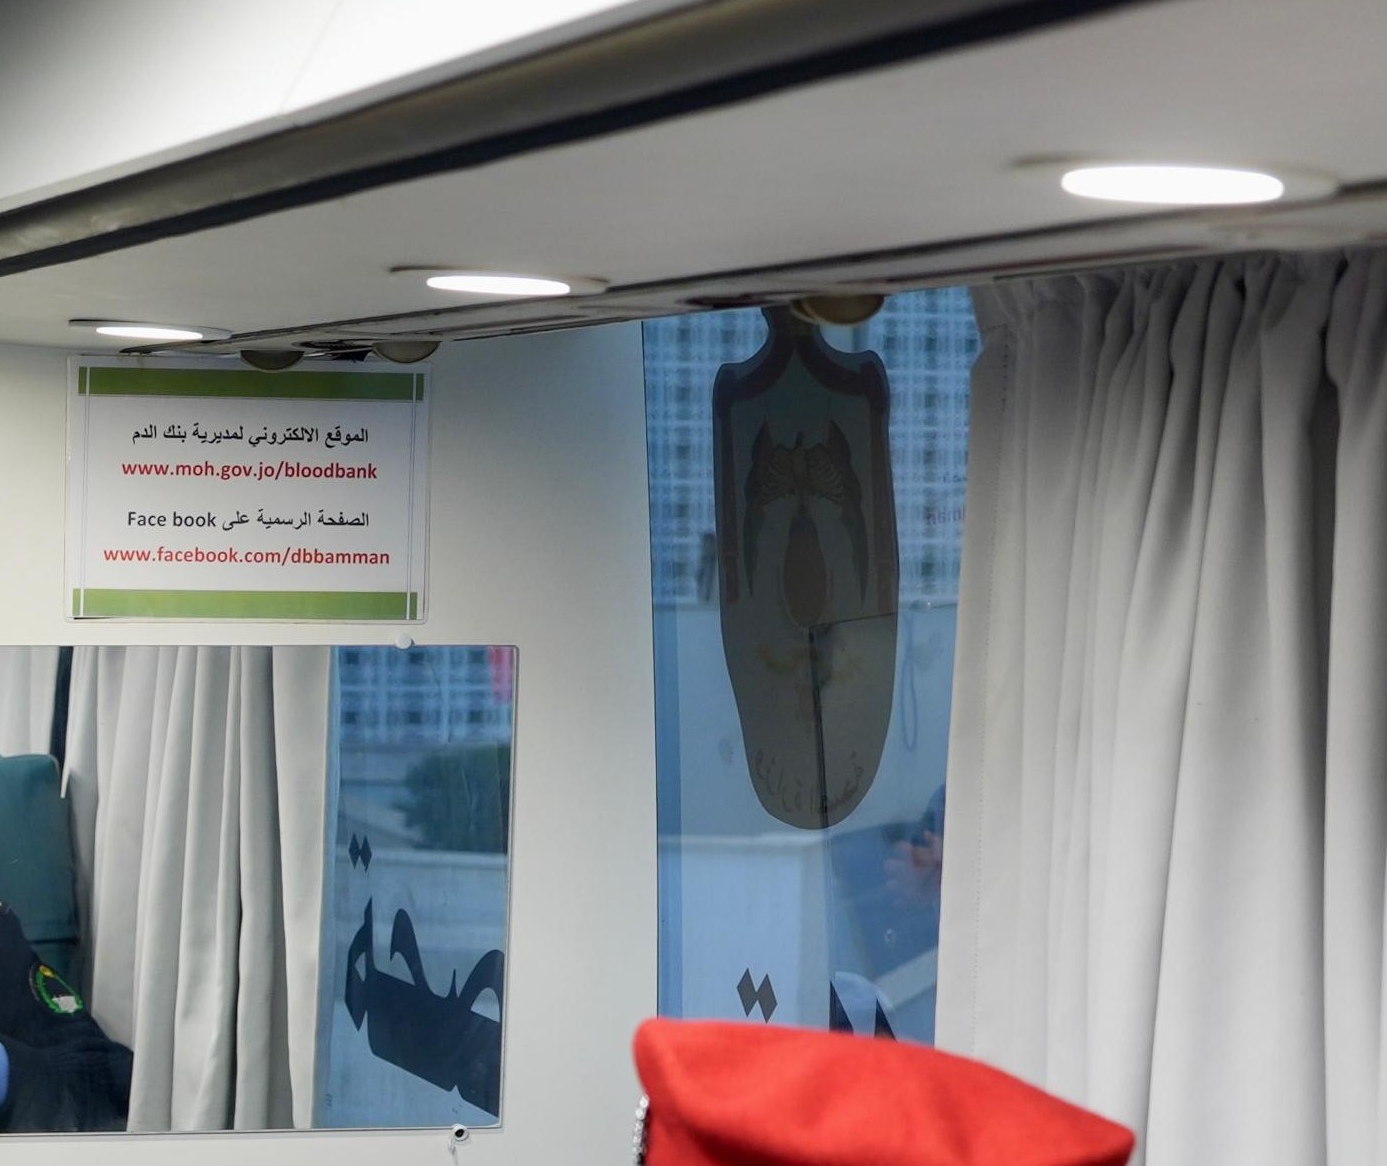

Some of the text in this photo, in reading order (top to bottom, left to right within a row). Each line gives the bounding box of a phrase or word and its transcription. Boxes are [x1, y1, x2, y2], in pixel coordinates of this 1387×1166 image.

[131, 421, 369, 449] الموقع الالكتروني لمديرية بنك الدم
[121, 460, 378, 481] www.moh.gov.jo/bloodbank
[127, 510, 167, 527] Face
[172, 510, 217, 528] book
[256, 508, 312, 531] الرسمية
[316, 508, 370, 527] الصفحة
[103, 545, 390, 567] www.facebook.com/dbbamman
